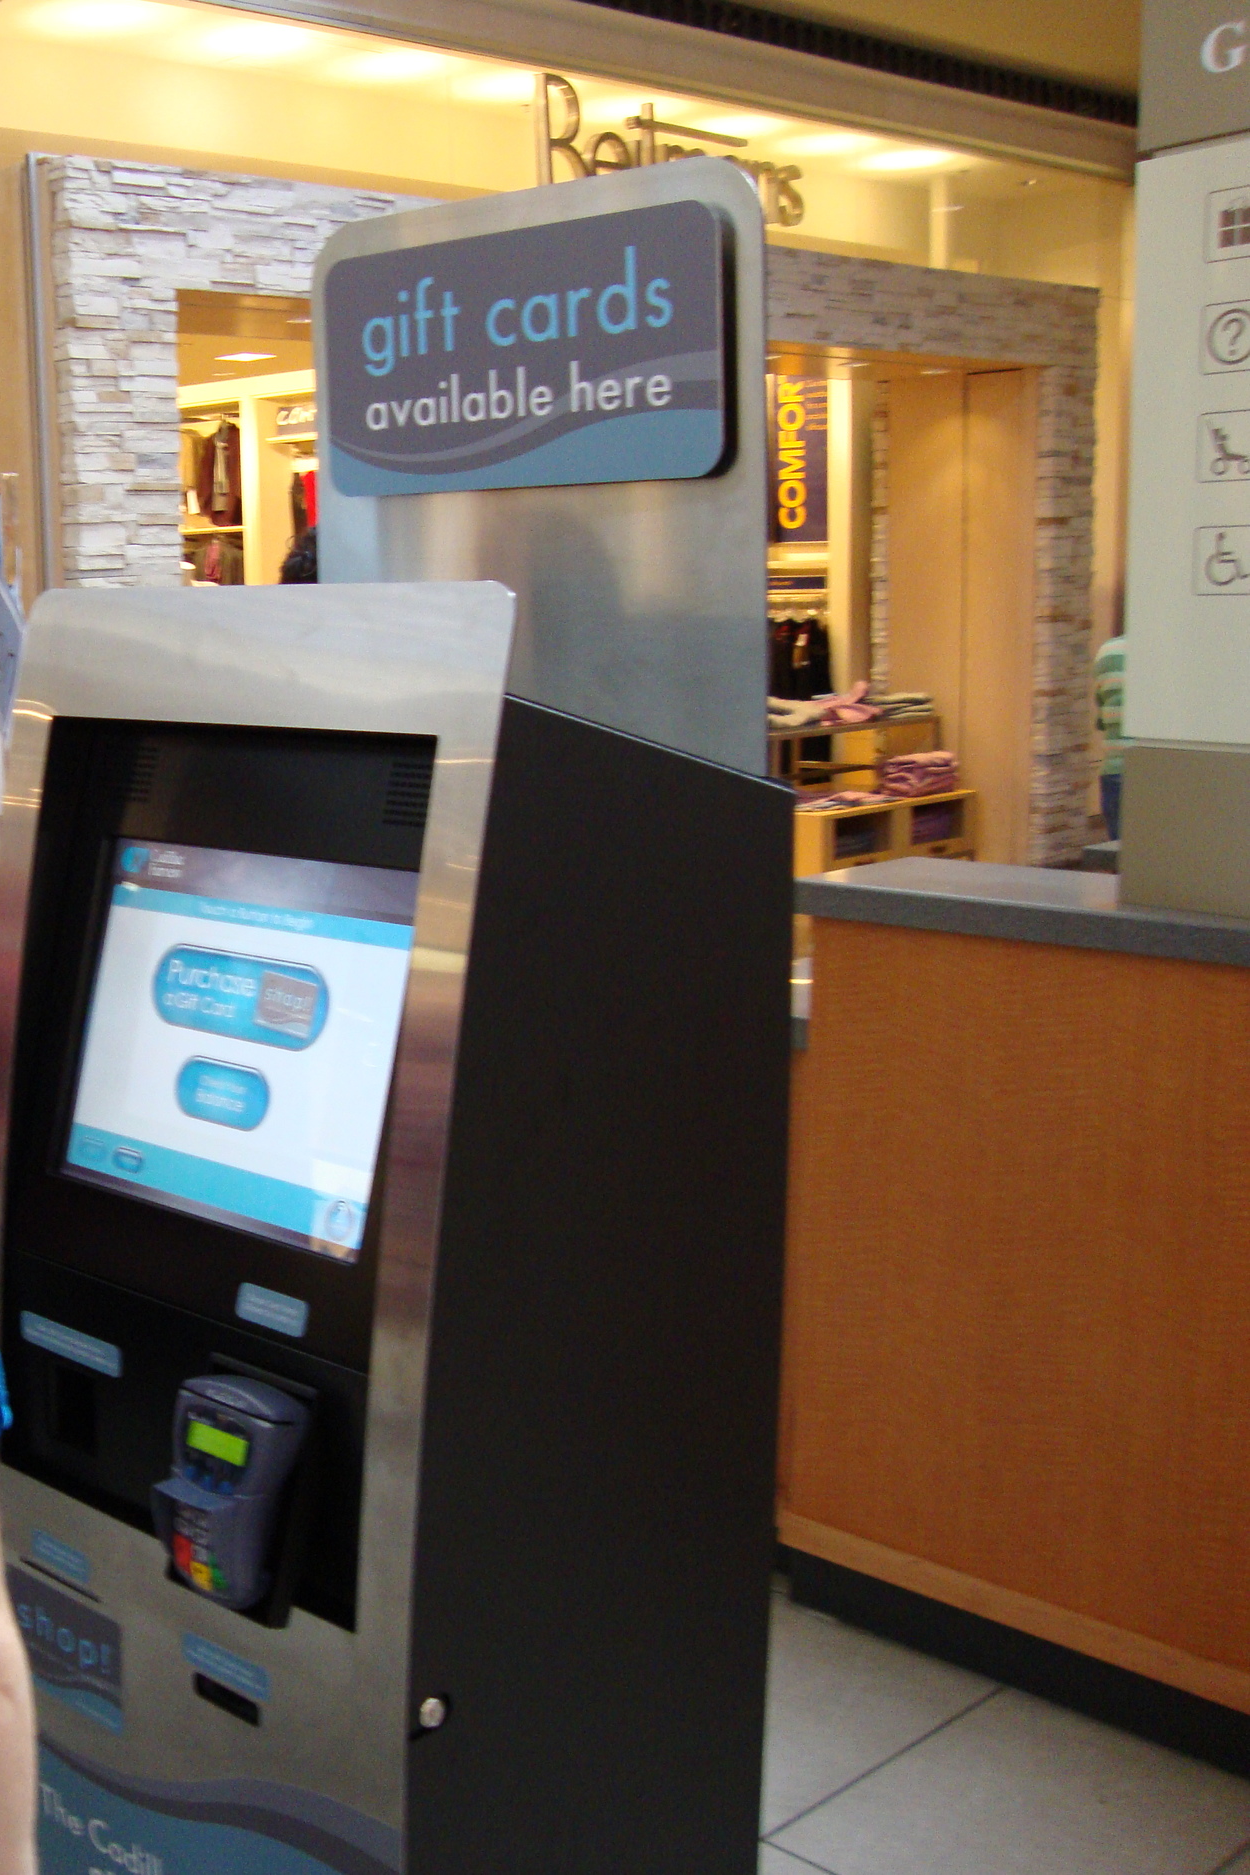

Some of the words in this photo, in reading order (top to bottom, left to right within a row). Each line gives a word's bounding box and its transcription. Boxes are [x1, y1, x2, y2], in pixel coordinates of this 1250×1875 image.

[362, 276, 461, 377] gift
[485, 245, 673, 346] cards
[365, 366, 554, 431] available
[569, 360, 672, 412] here
[166, 959, 257, 998] Purchase
